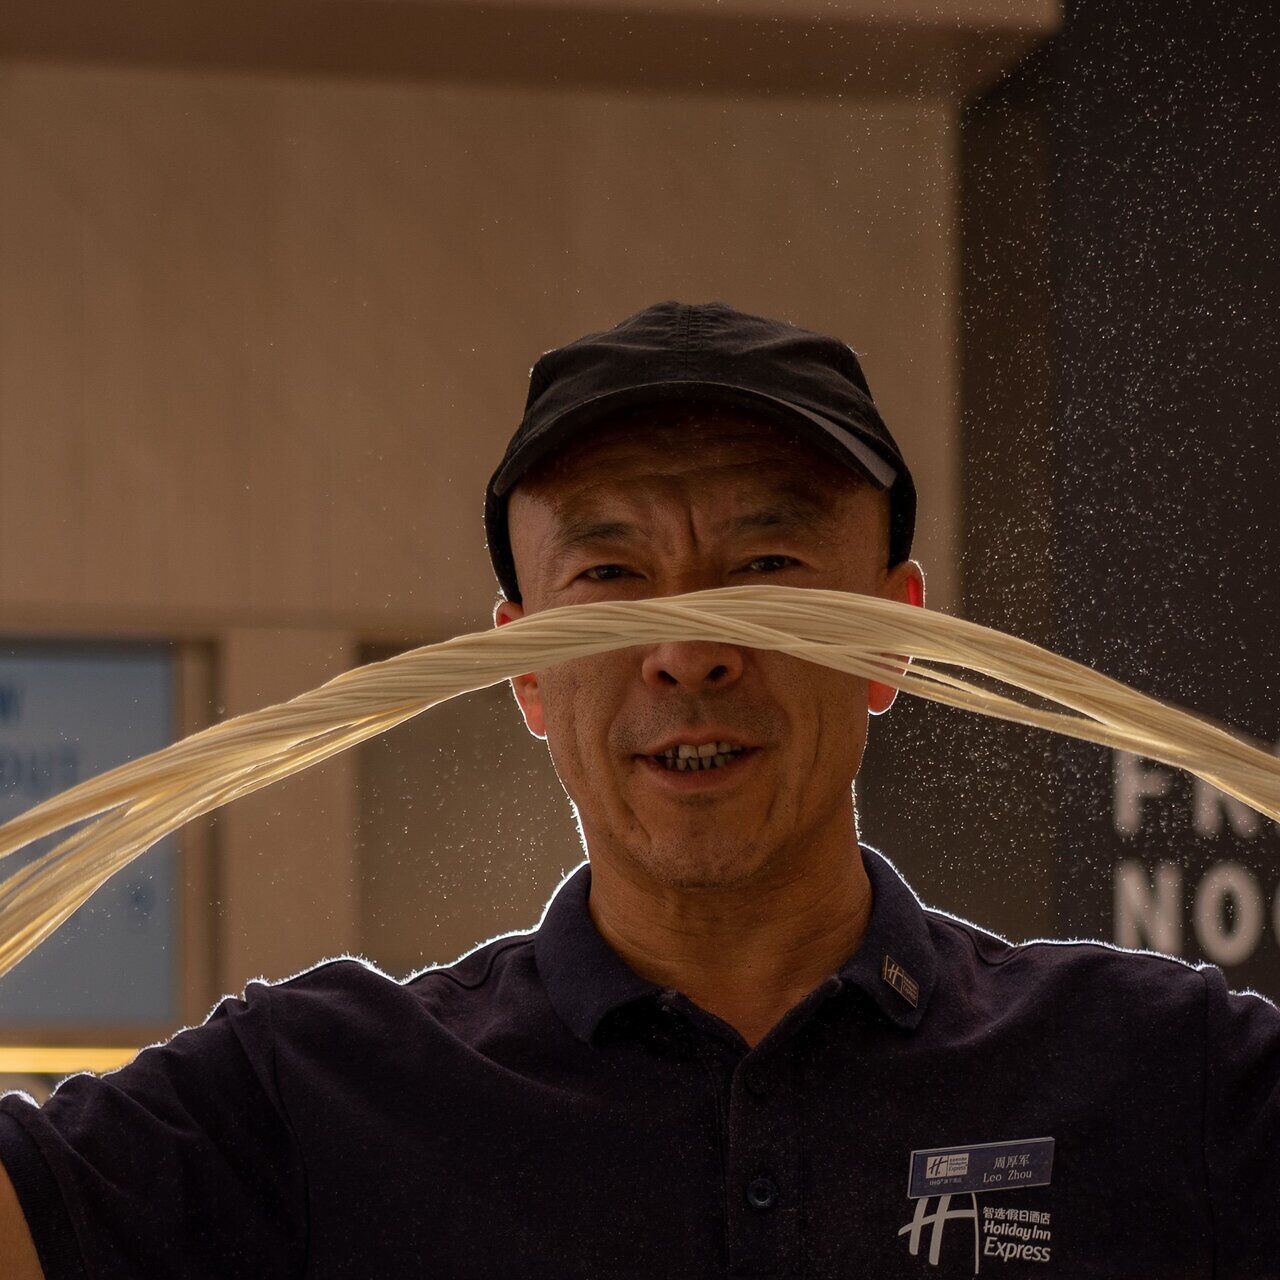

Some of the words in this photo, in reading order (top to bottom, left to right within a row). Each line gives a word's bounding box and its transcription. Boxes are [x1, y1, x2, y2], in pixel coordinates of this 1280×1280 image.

[1008, 1169, 1032, 1181] Zhou
[983, 1206, 1052, 1225] 智选假日酒店
[983, 1220, 1032, 1241] Holiday
[1032, 1224, 1052, 1241] Inn
[984, 1236, 1052, 1263] Express
